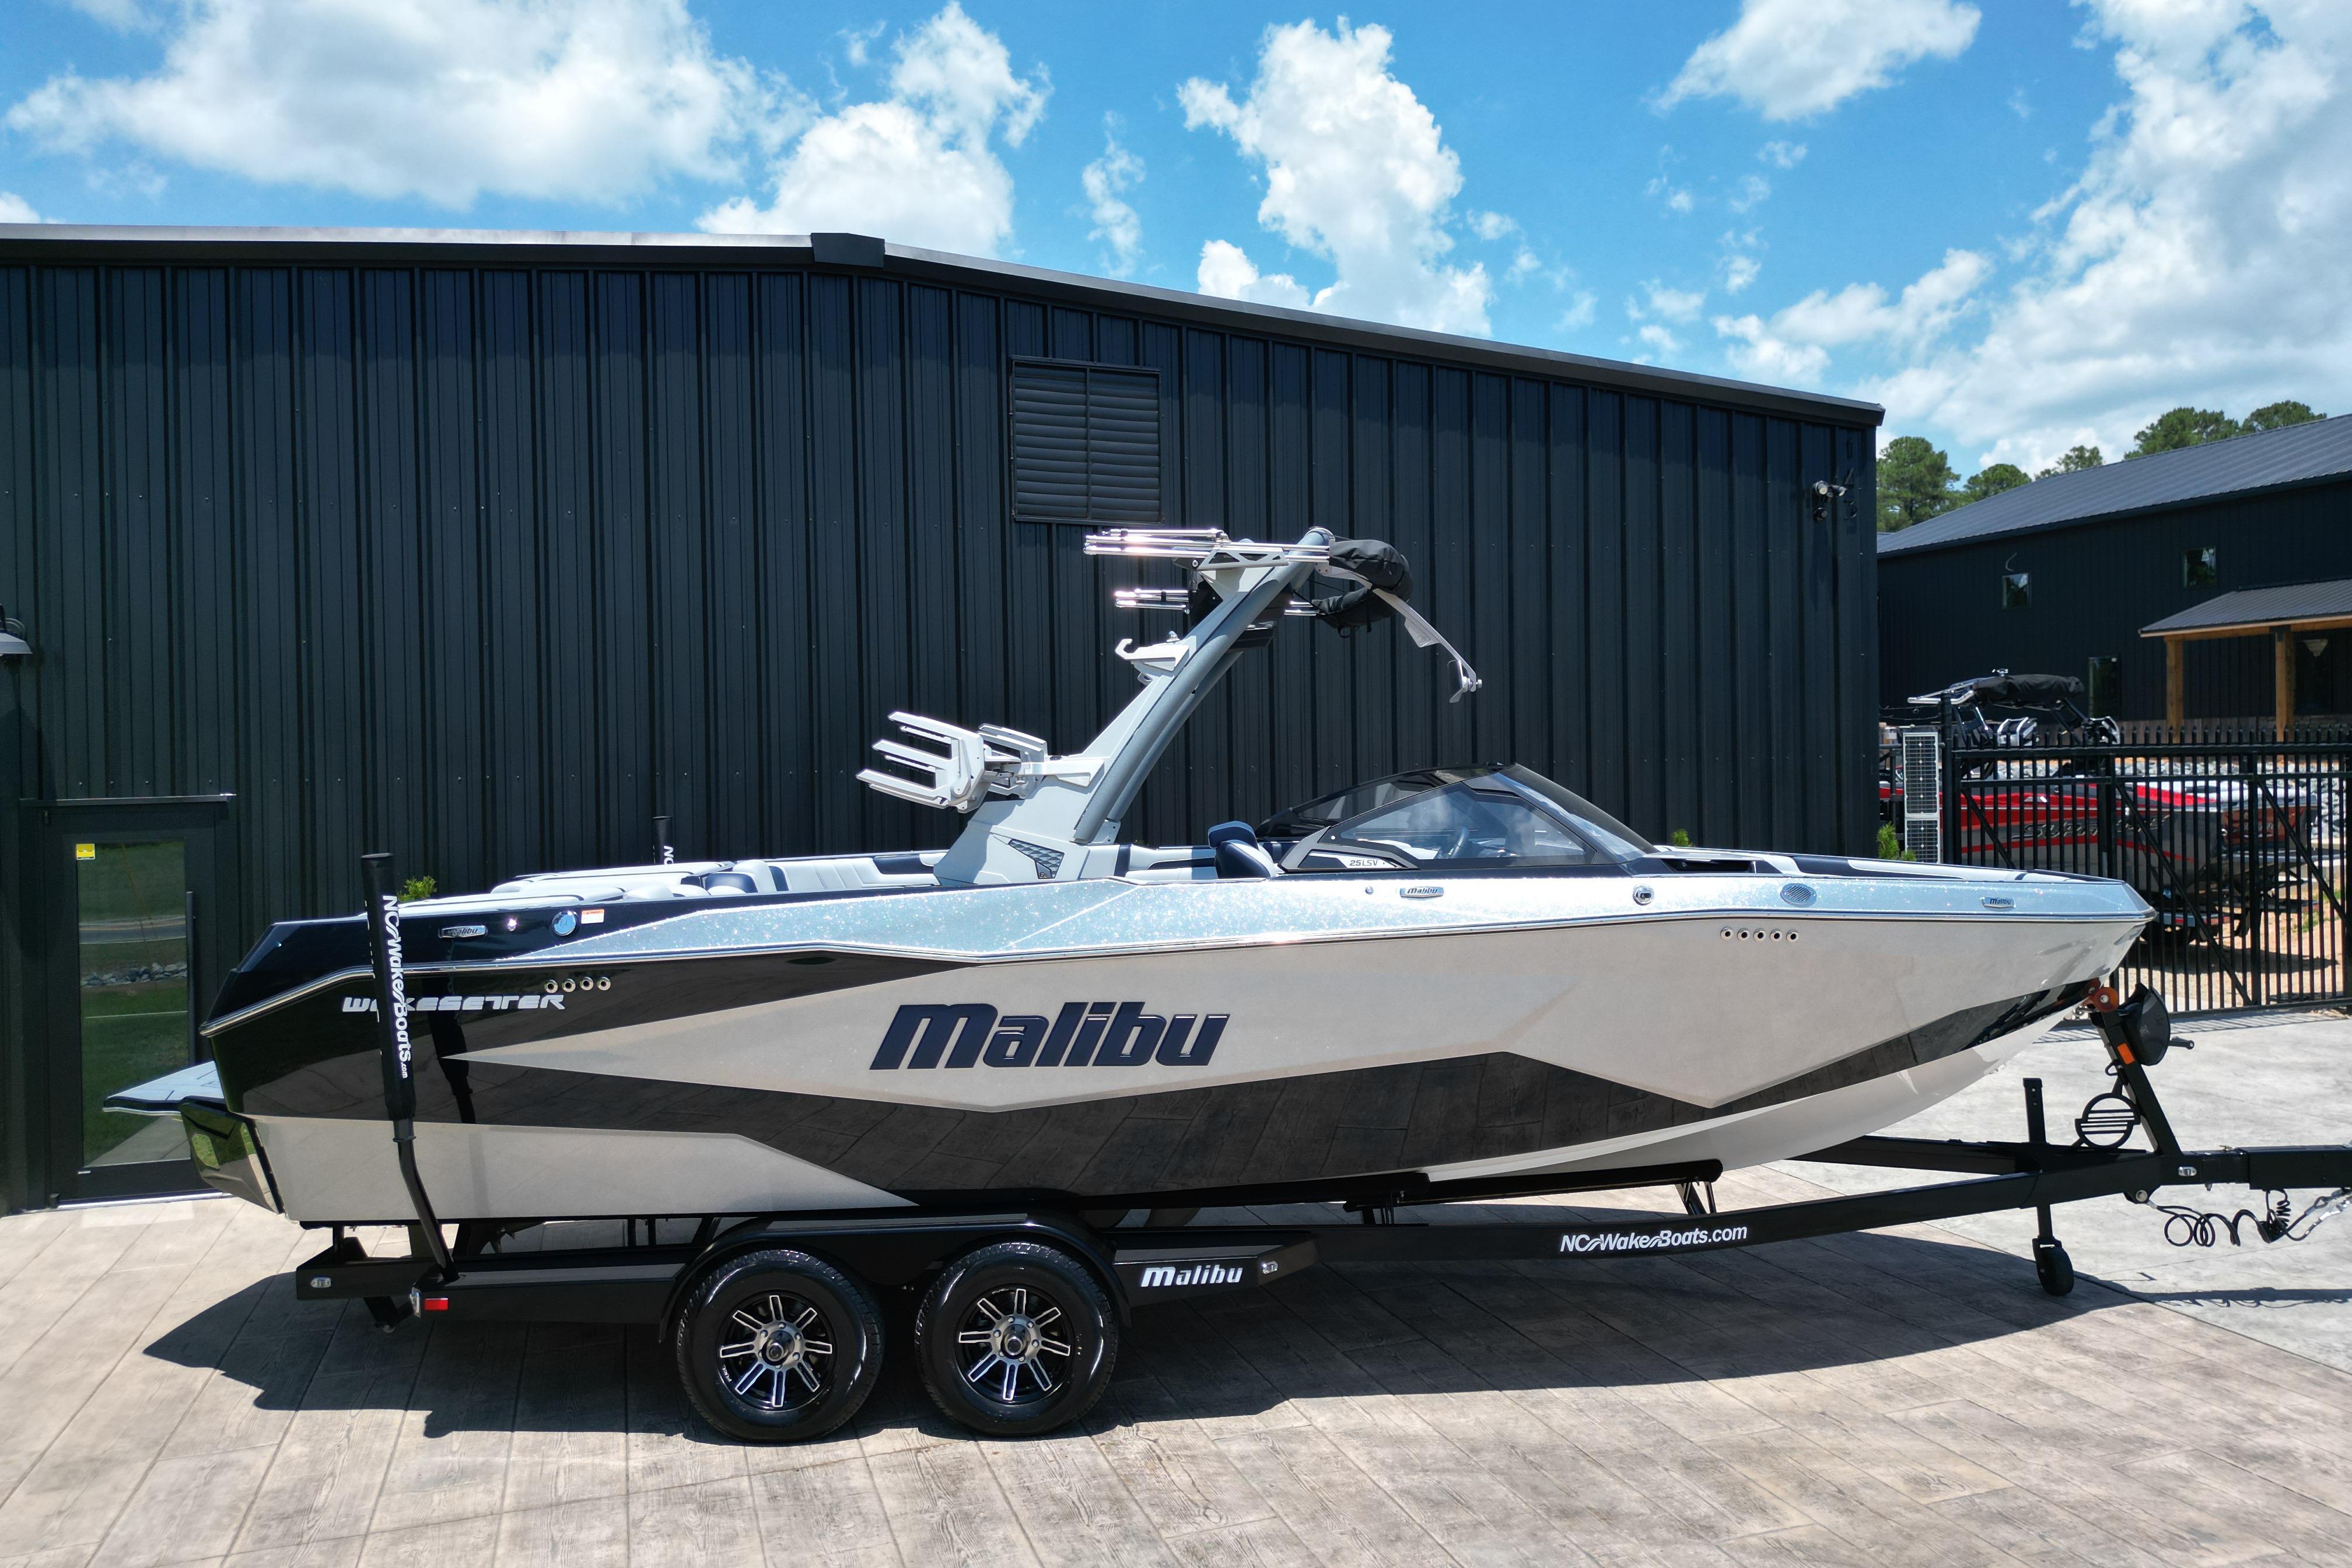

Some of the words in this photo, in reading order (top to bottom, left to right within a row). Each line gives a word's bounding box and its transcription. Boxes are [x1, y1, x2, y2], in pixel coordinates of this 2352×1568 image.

[342, 995, 565, 1012] WESETTER
[869, 1001, 1231, 1070] Malibu
[1140, 1264, 1244, 1287] Malibu
